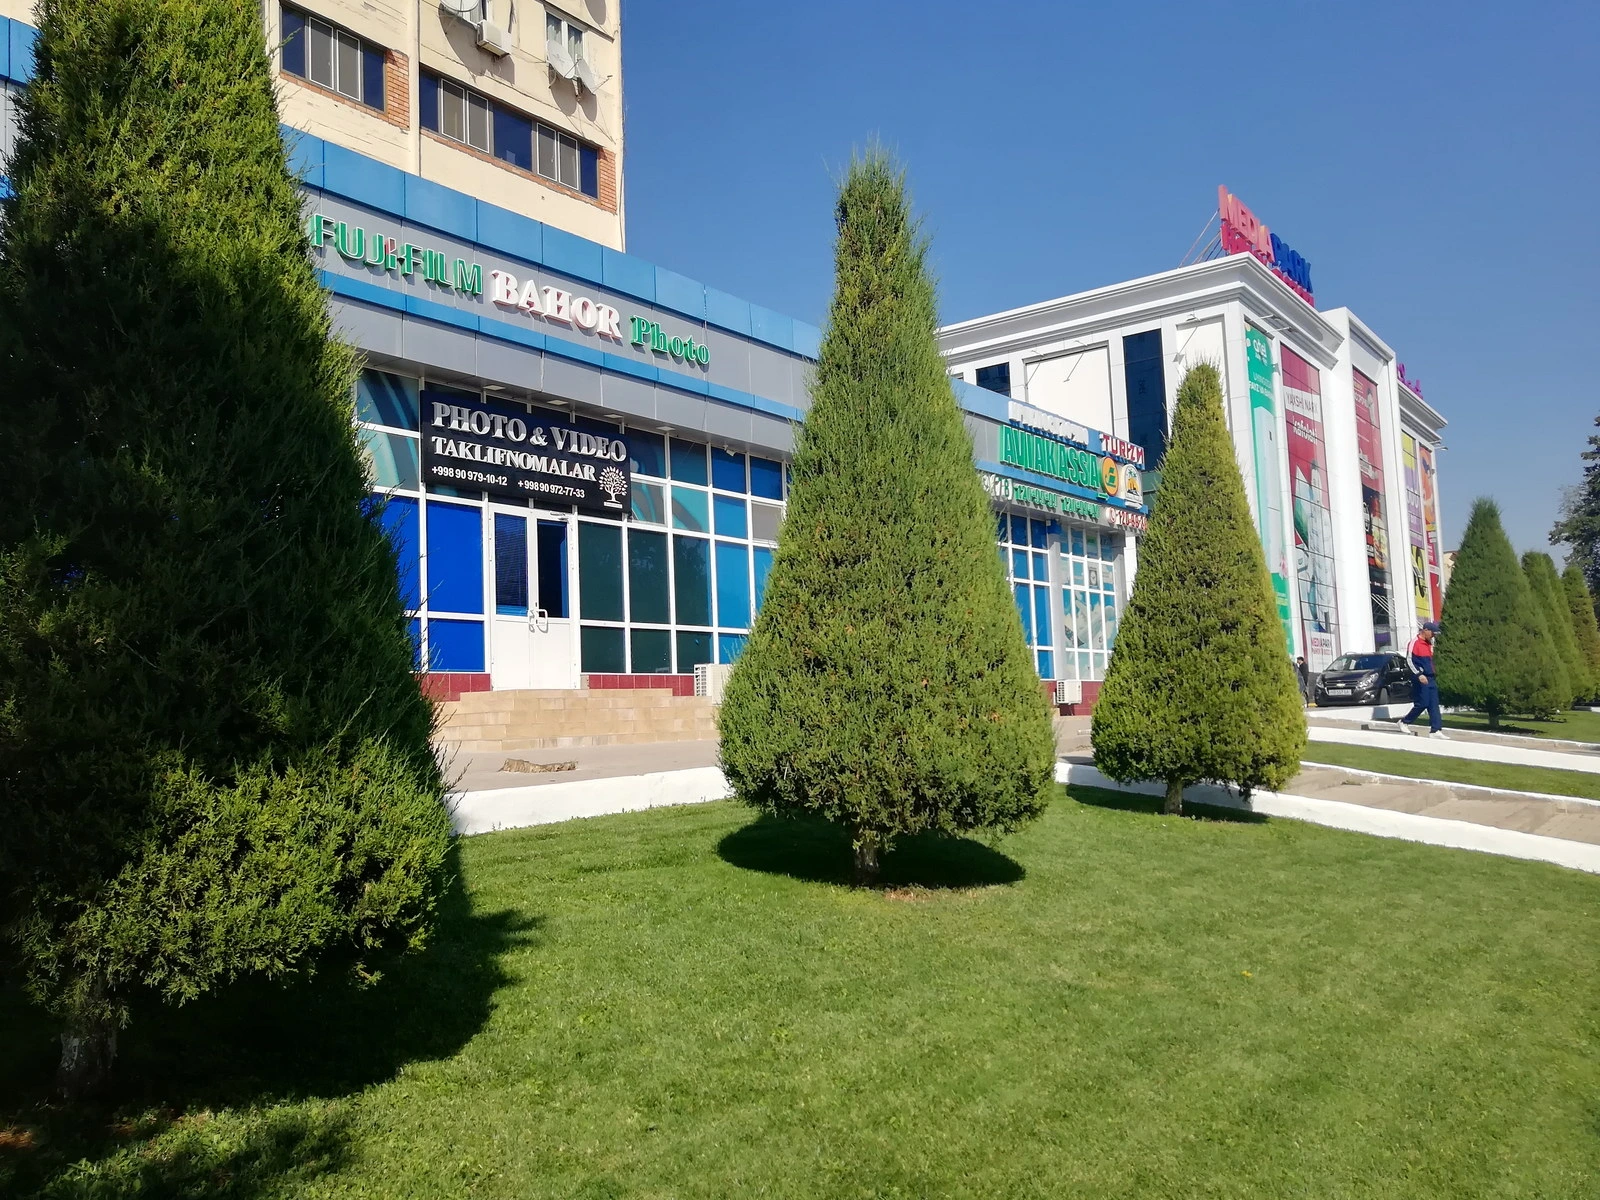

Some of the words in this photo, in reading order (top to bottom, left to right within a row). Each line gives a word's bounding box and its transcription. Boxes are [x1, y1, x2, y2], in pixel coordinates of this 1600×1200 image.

[310, 213, 483, 295] FUJIFILM
[491, 270, 623, 339] BAHOR
[629, 315, 711, 365] Photo
[431, 402, 527, 442] PHOTO
[530, 427, 549, 447] &
[550, 426, 627, 462] VIDEO
[431, 436, 597, 482] TAKLIFNOMALAR
[1000, 425, 1101, 489] AVIAKASSA
[1100, 431, 1145, 465] TURIZM
